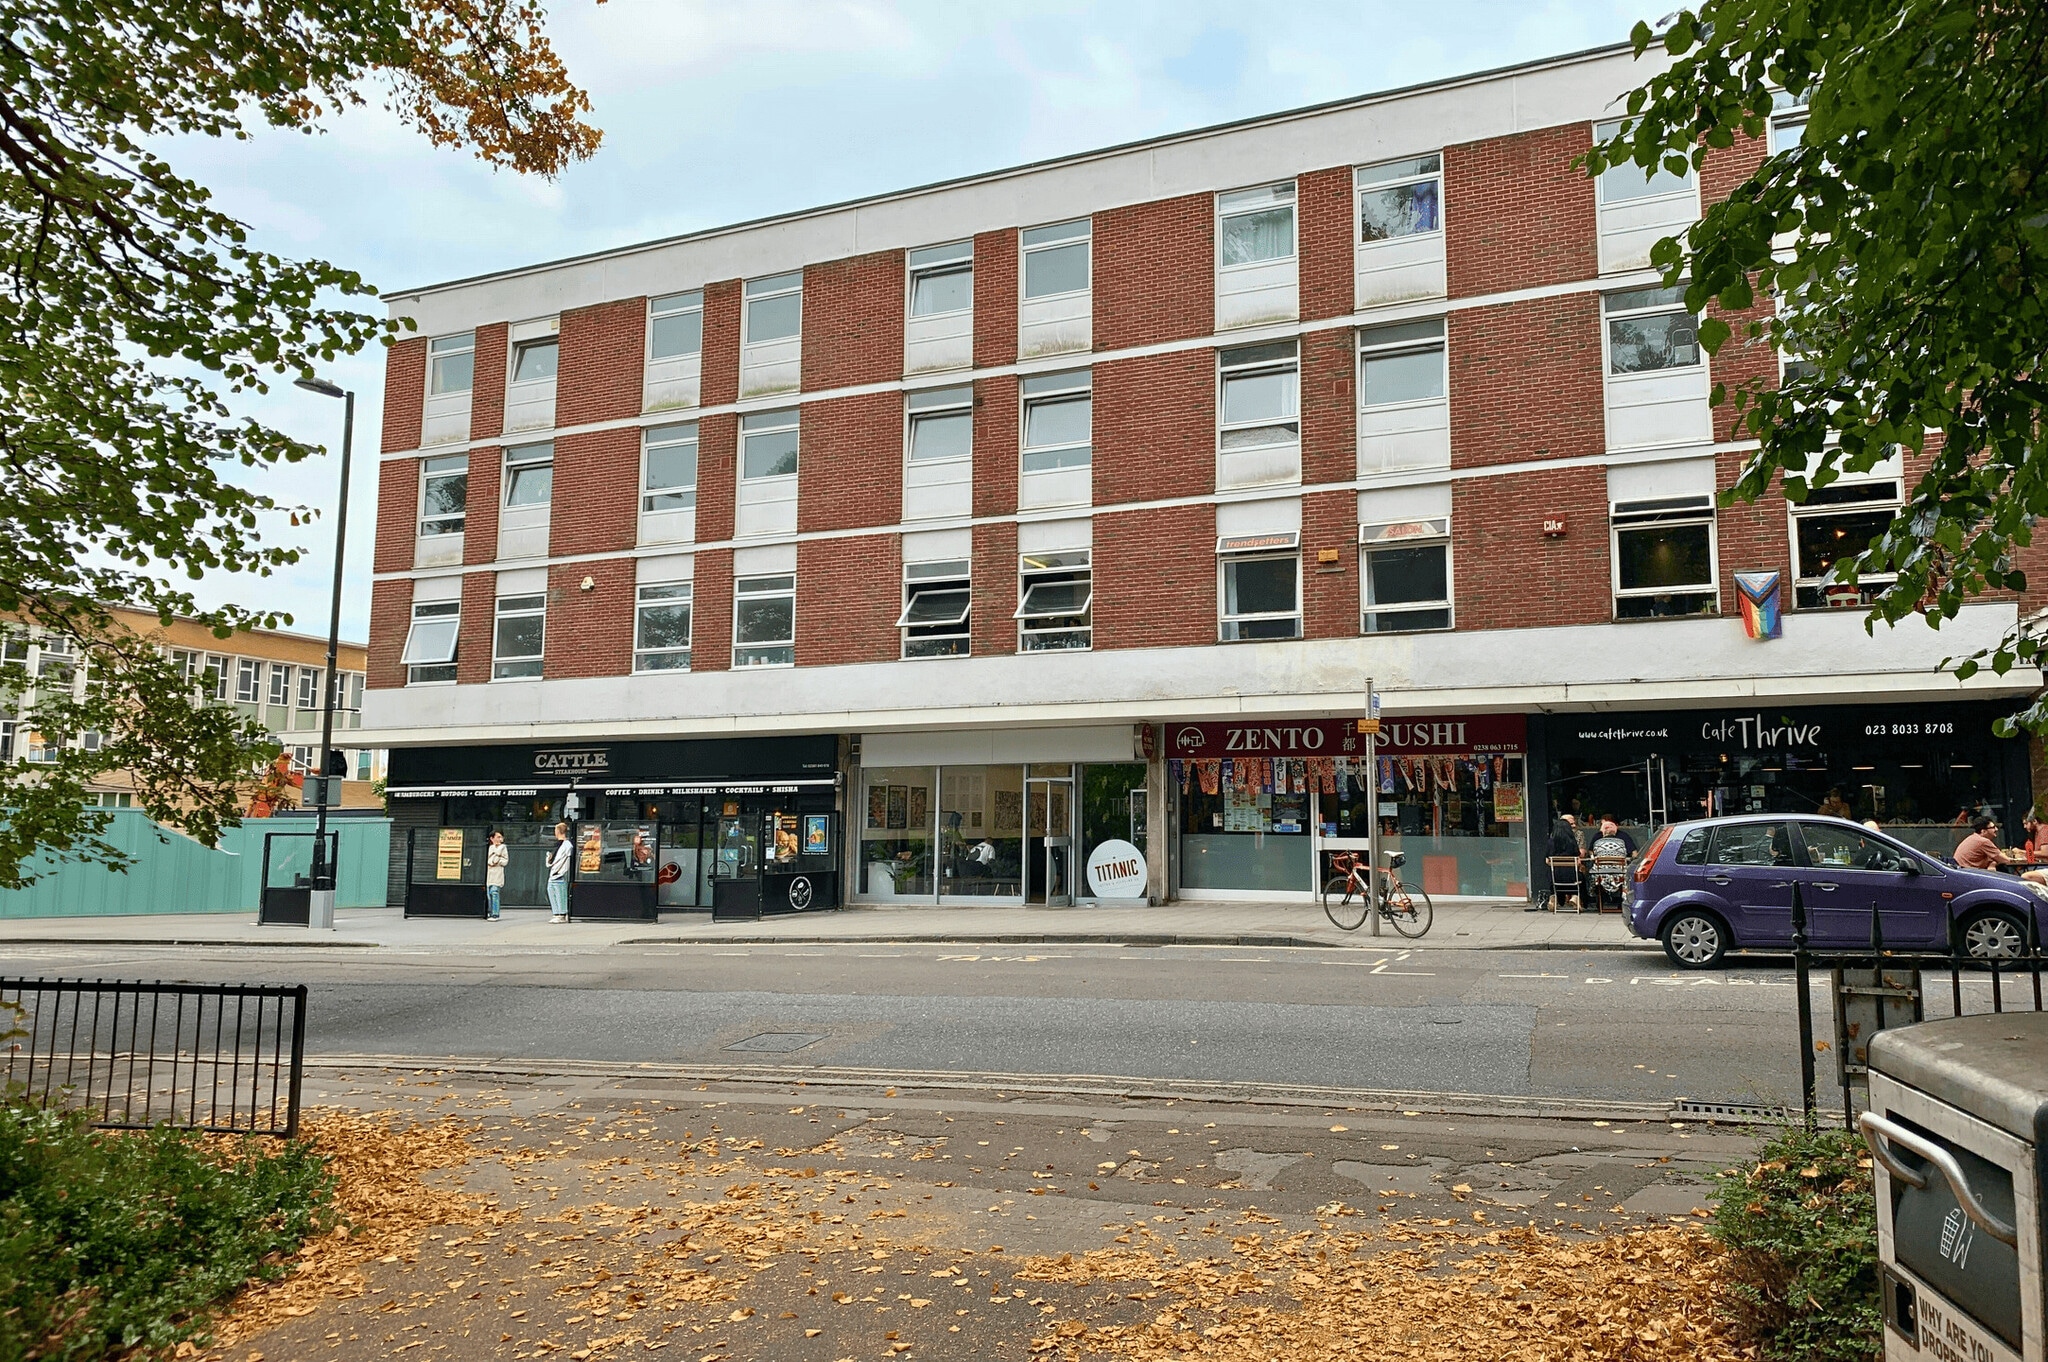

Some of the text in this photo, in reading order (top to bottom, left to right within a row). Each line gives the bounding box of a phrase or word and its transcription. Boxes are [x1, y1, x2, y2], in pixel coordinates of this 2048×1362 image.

[1226, 537, 1289, 548] trendsetters
[1225, 727, 1324, 751] ZENTO
[1374, 722, 1468, 747] SUSHI
[1702, 713, 1821, 749] Cafe Thrive
[1865, 723, 1953, 735] 023 8033 8708
[534, 753, 609, 769] CATTLE
[1095, 859, 1139, 882] TITANIC
[1919, 1296, 1942, 1332] WHY
[1946, 1318, 1967, 1353] ARE
